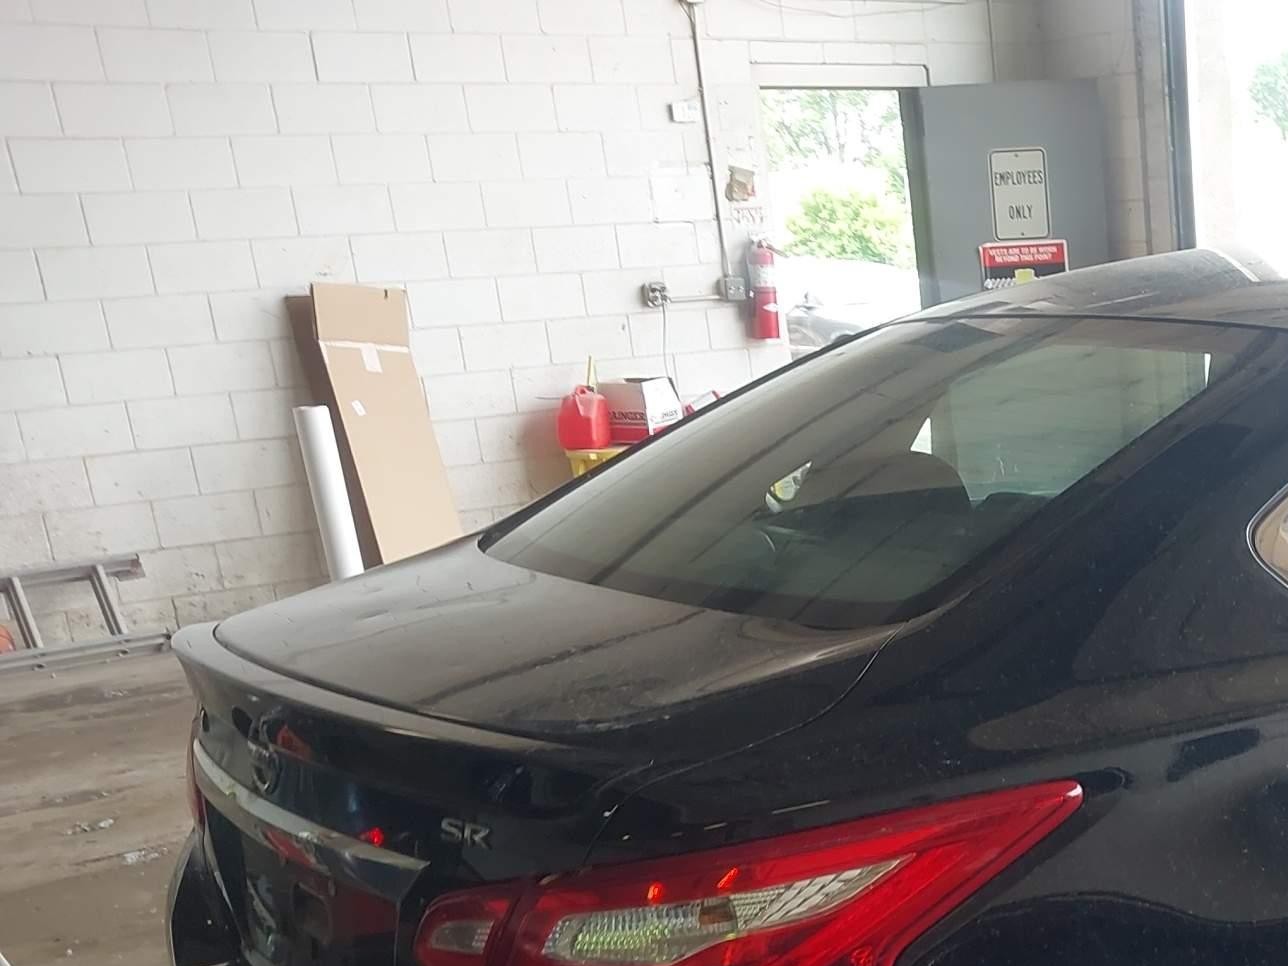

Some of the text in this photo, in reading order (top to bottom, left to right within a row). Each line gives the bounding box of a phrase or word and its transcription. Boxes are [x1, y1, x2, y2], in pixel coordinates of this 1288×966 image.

[994, 169, 1044, 186] EMPLOYEES
[1008, 204, 1033, 220] ONLY
[441, 817, 491, 849] SR
